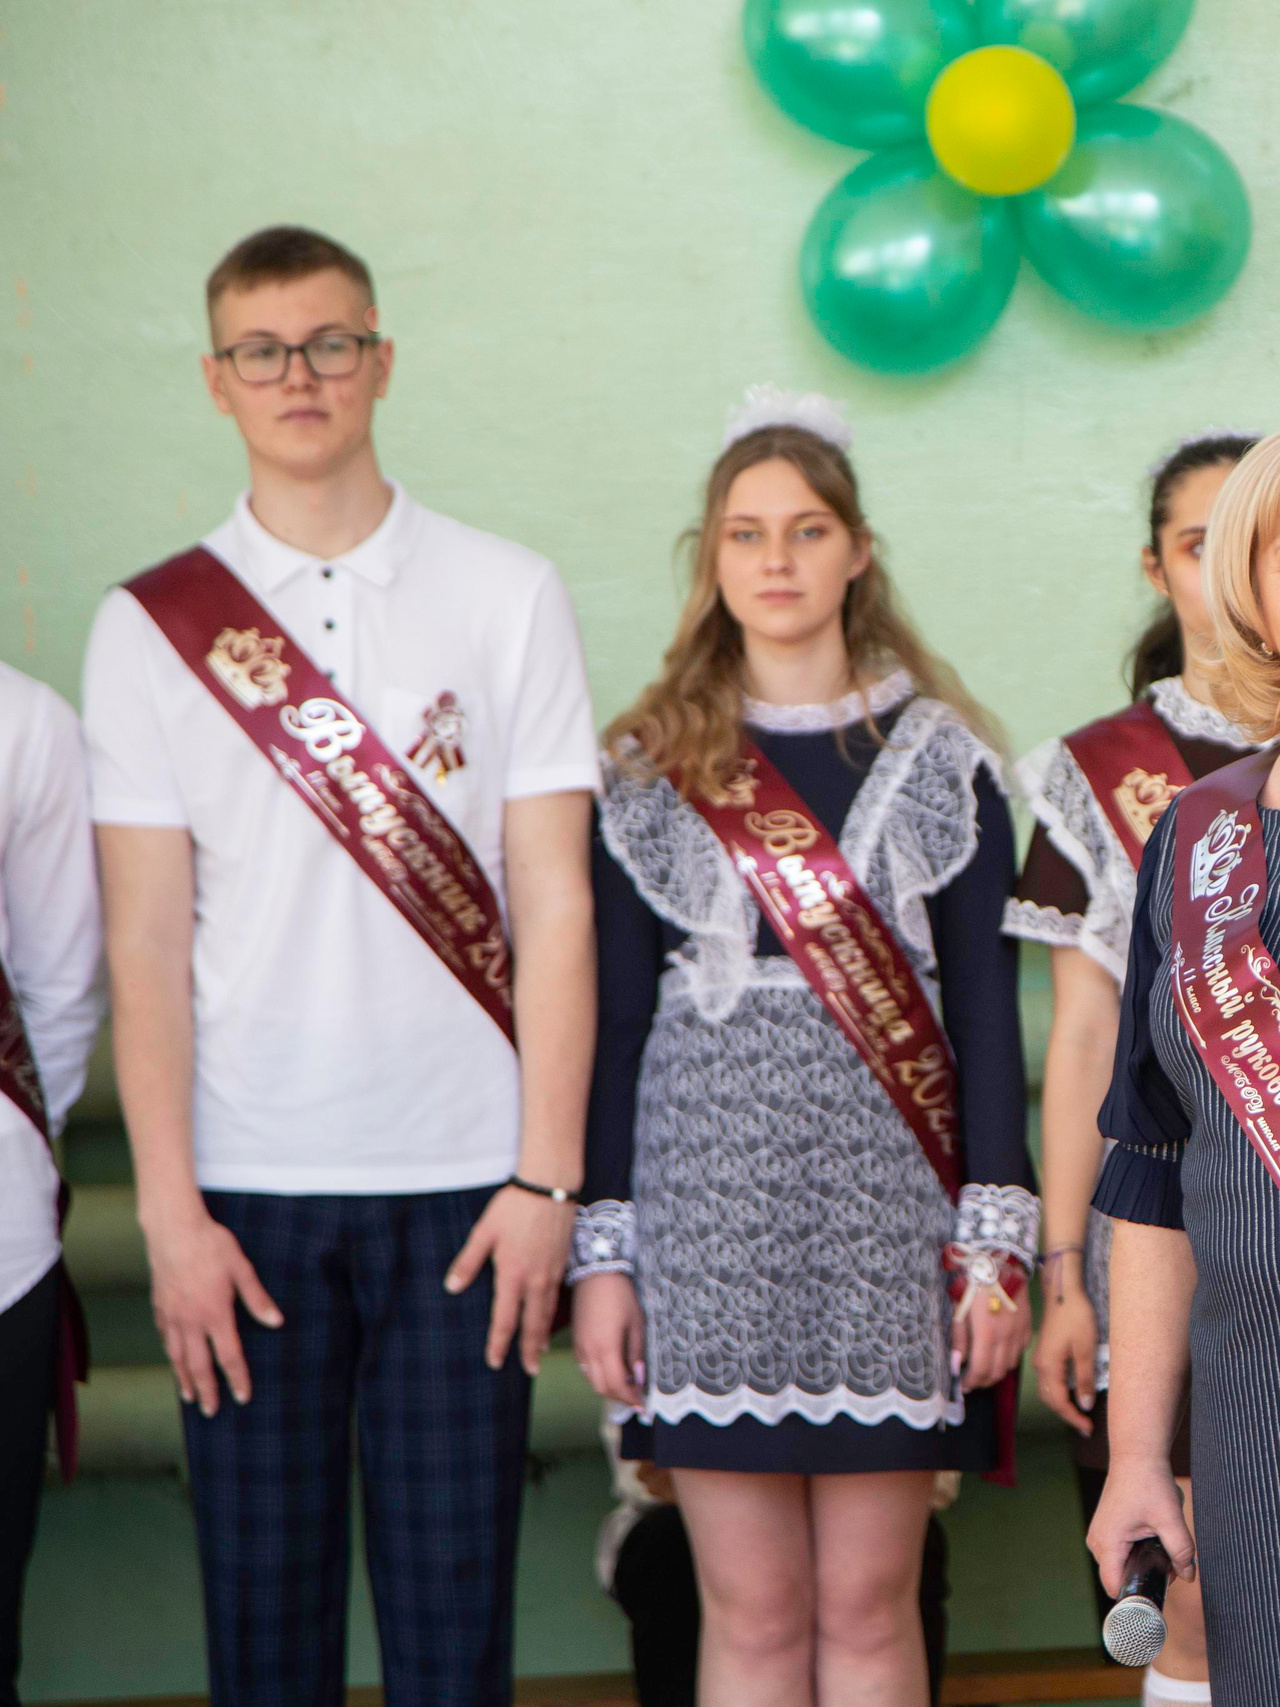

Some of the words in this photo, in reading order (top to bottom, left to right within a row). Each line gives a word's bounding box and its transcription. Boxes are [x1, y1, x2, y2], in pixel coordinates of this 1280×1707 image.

[279, 697, 487, 932] Выпускник
[466, 919, 513, 1008] 20
[744, 809, 915, 1042] Выпускница
[892, 1043, 956, 1156] 202
[1183, 967, 1197, 982] 11
[1202, 883, 1260, 1019] Классный
[1256, 1116, 1280, 1151] школа
